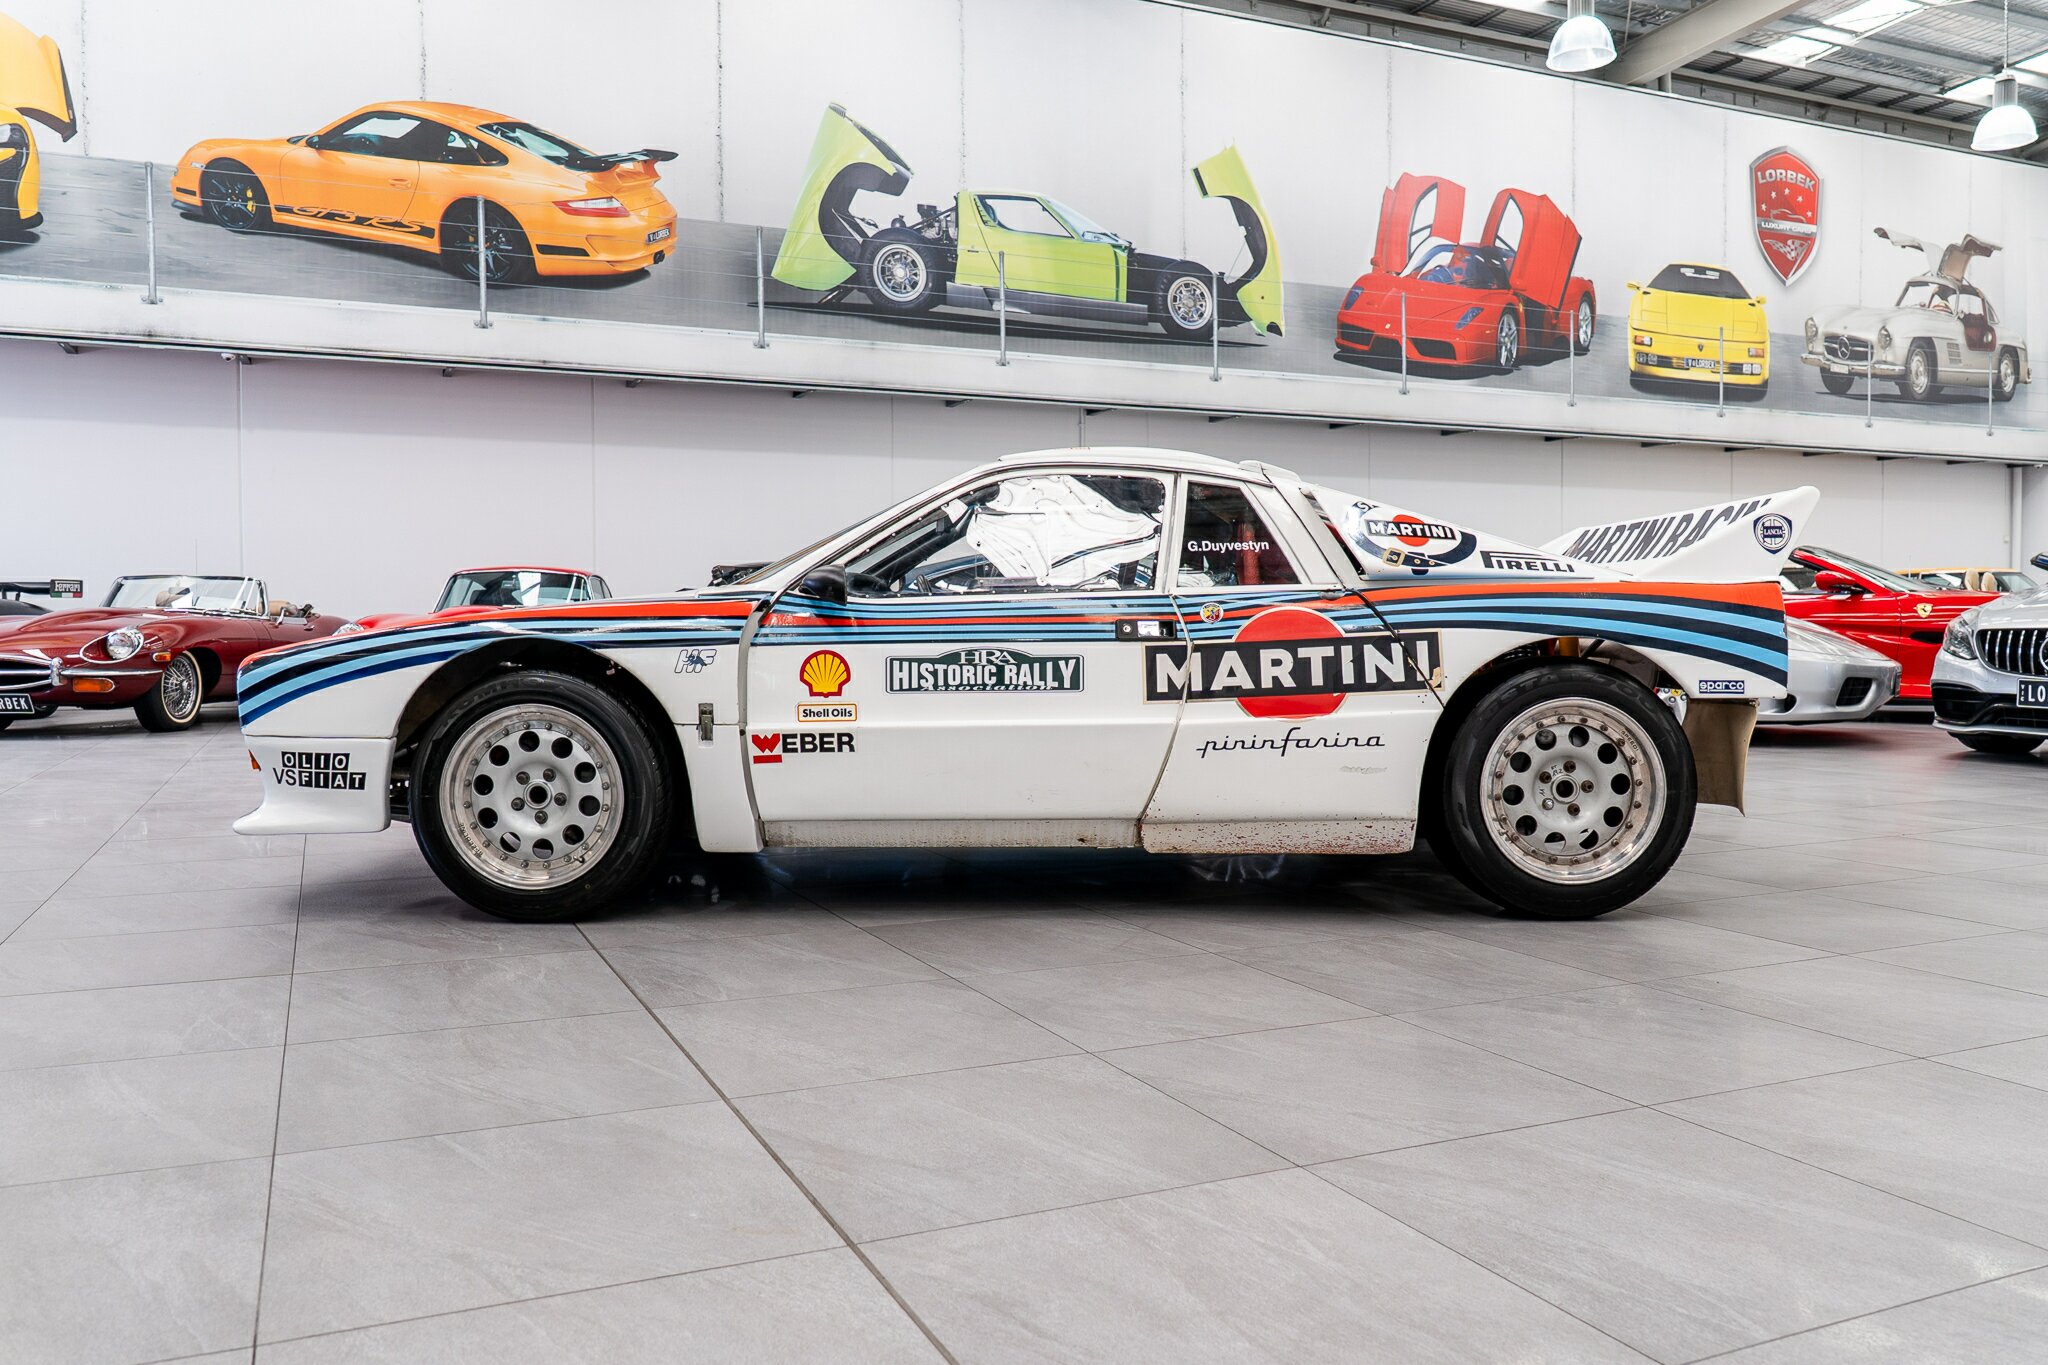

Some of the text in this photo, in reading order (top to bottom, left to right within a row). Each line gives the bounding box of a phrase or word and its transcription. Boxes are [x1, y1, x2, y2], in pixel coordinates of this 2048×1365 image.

[1757, 168, 1816, 192] LORBEK
[362, 215, 425, 232] RS
[1761, 221, 1790, 231] LUXURY
[1368, 521, 1453, 538] MARTINI
[1187, 540, 1270, 553] G.Duyvestyn
[1562, 516, 1676, 564] MARTINI
[1480, 550, 1575, 573] PIRELLI
[54, 580, 81, 592] Ferrari
[958, 649, 1018, 666] HRA
[893, 658, 1077, 691] HISTORIC RALLY
[1156, 640, 1431, 693] MARTINI
[920, 683, 1054, 691] Association
[1699, 681, 1744, 692] sparco
[802, 708, 853, 718] Shell Oils
[751, 732, 856, 754] WEBER
[1196, 727, 1386, 759] pininfarina
[283, 752, 347, 769] OLIO
[272, 768, 363, 788] VS FIAT
